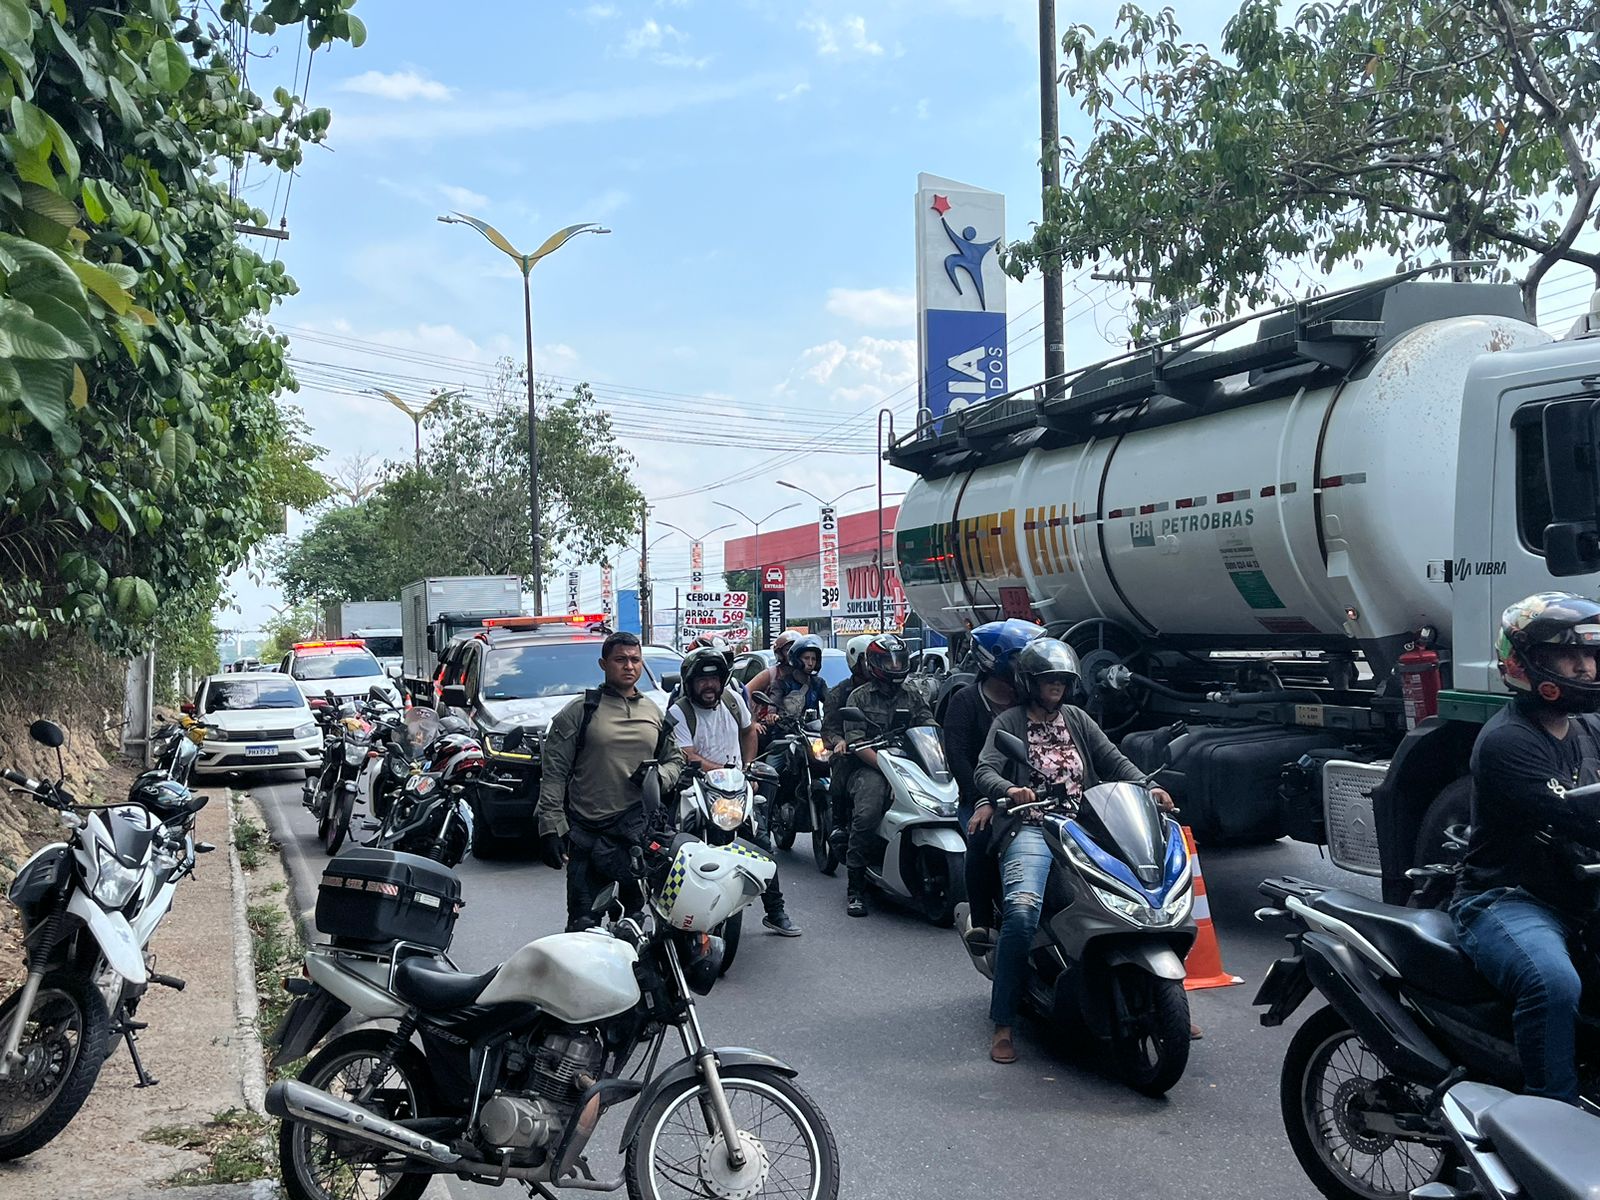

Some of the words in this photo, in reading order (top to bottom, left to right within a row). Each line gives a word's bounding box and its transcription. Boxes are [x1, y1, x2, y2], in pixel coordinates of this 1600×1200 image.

[1132, 521, 1152, 538] BR
[1161, 508, 1254, 535] PETROBRAS
[1475, 561, 1507, 575] VIBRA
[568, 571, 579, 608] SEXTA
[686, 593, 721, 602] CEBOLA
[685, 609, 714, 617] ARROZ
[685, 617, 717, 625] ZILMAR
